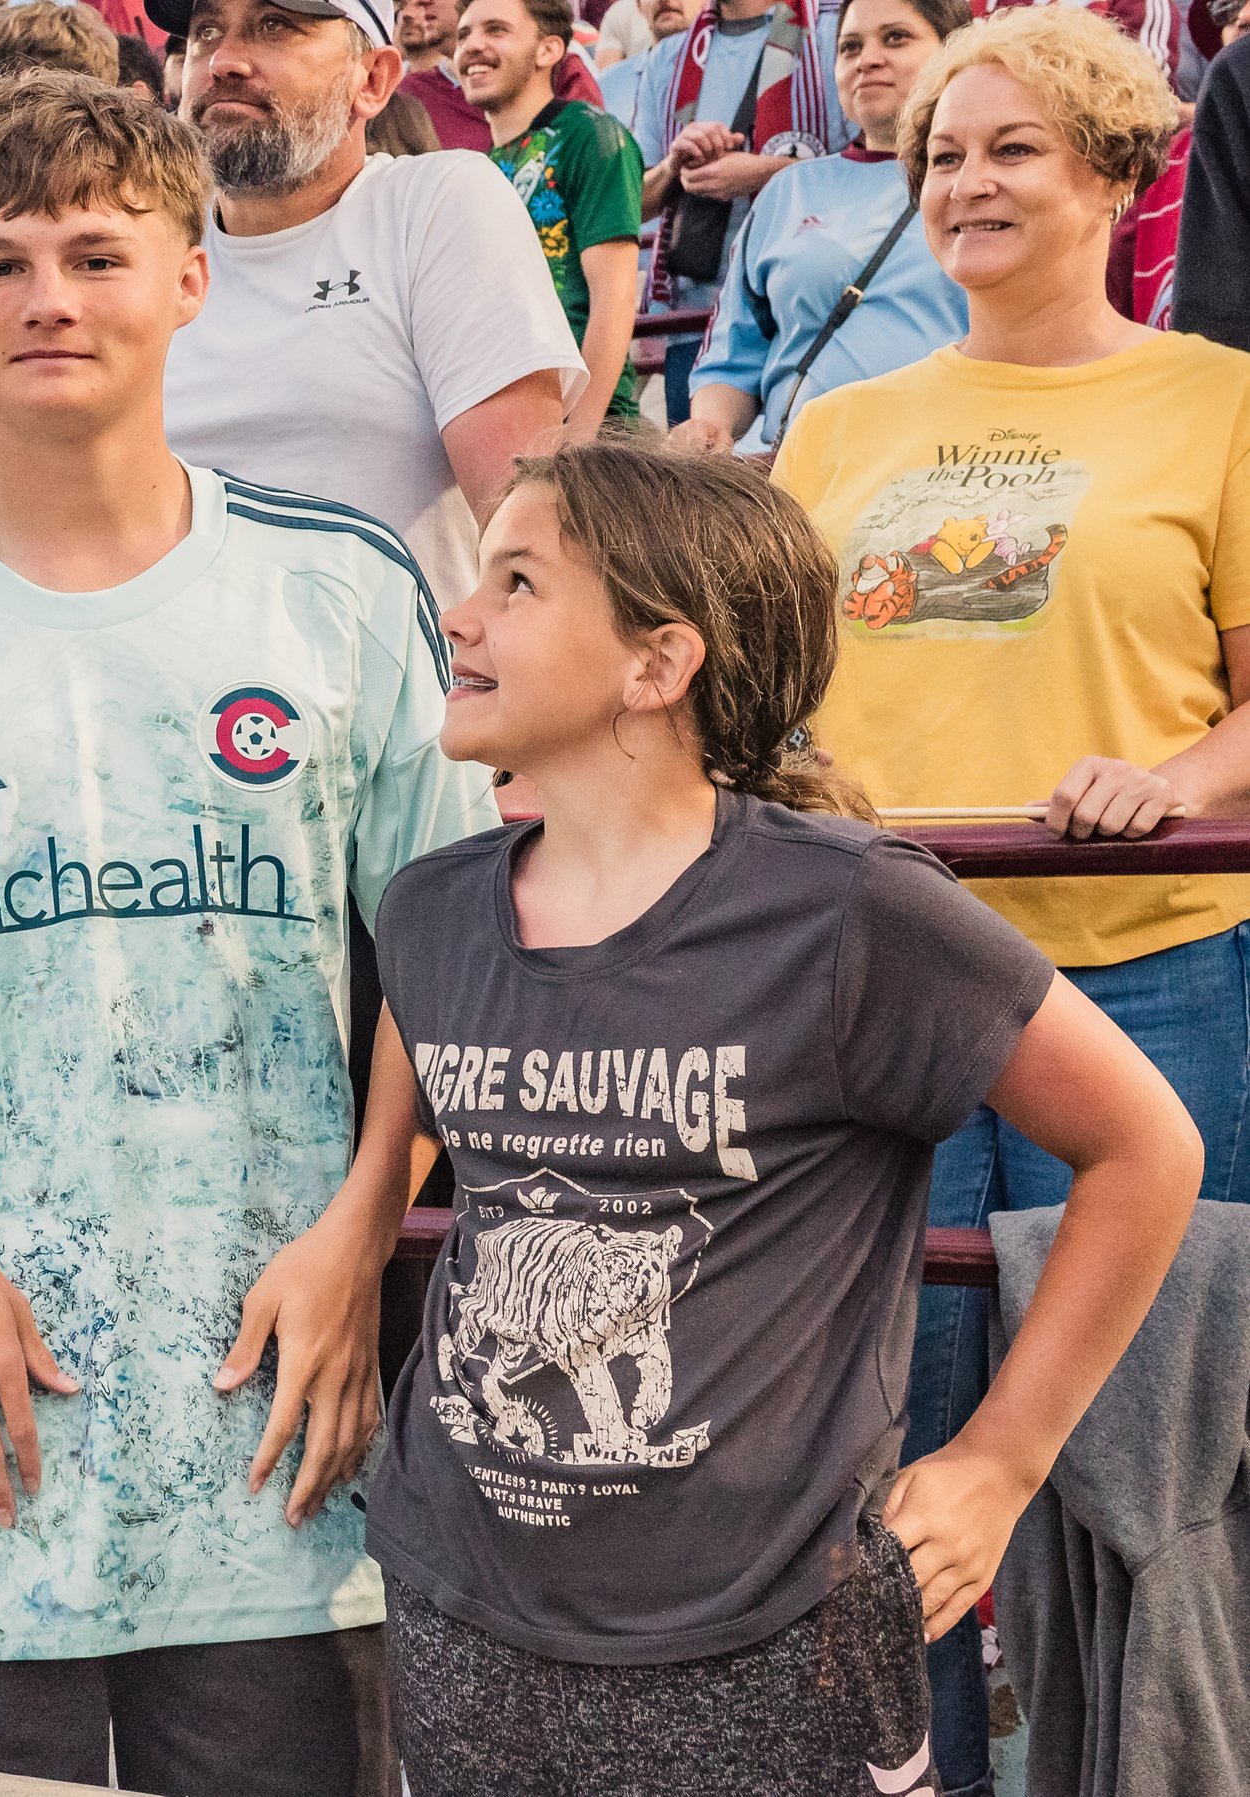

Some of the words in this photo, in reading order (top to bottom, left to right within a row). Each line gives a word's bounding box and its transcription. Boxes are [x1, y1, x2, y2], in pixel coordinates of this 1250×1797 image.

[305, 304, 331, 313] UNDER
[333, 297, 370, 307] ARMOUR
[987, 428, 1041, 443] Disney
[937, 445, 1061, 467] Winnie
[927, 468, 964, 482] the
[959, 465, 1056, 489] Pooh
[519, 1045, 759, 1182] SAUVAGE
[467, 1131, 493, 1151] ne
[502, 1132, 605, 1160] regrette
[613, 1132, 667, 1157] rien
[599, 1199, 652, 1215] 2002
[584, 1443, 639, 1463] WILD
[649, 1446, 689, 1463] NE
[592, 1484, 640, 1496] LOYAL
[519, 1494, 562, 1511] BRAVE
[498, 1506, 571, 1527] AUTHENTIC
